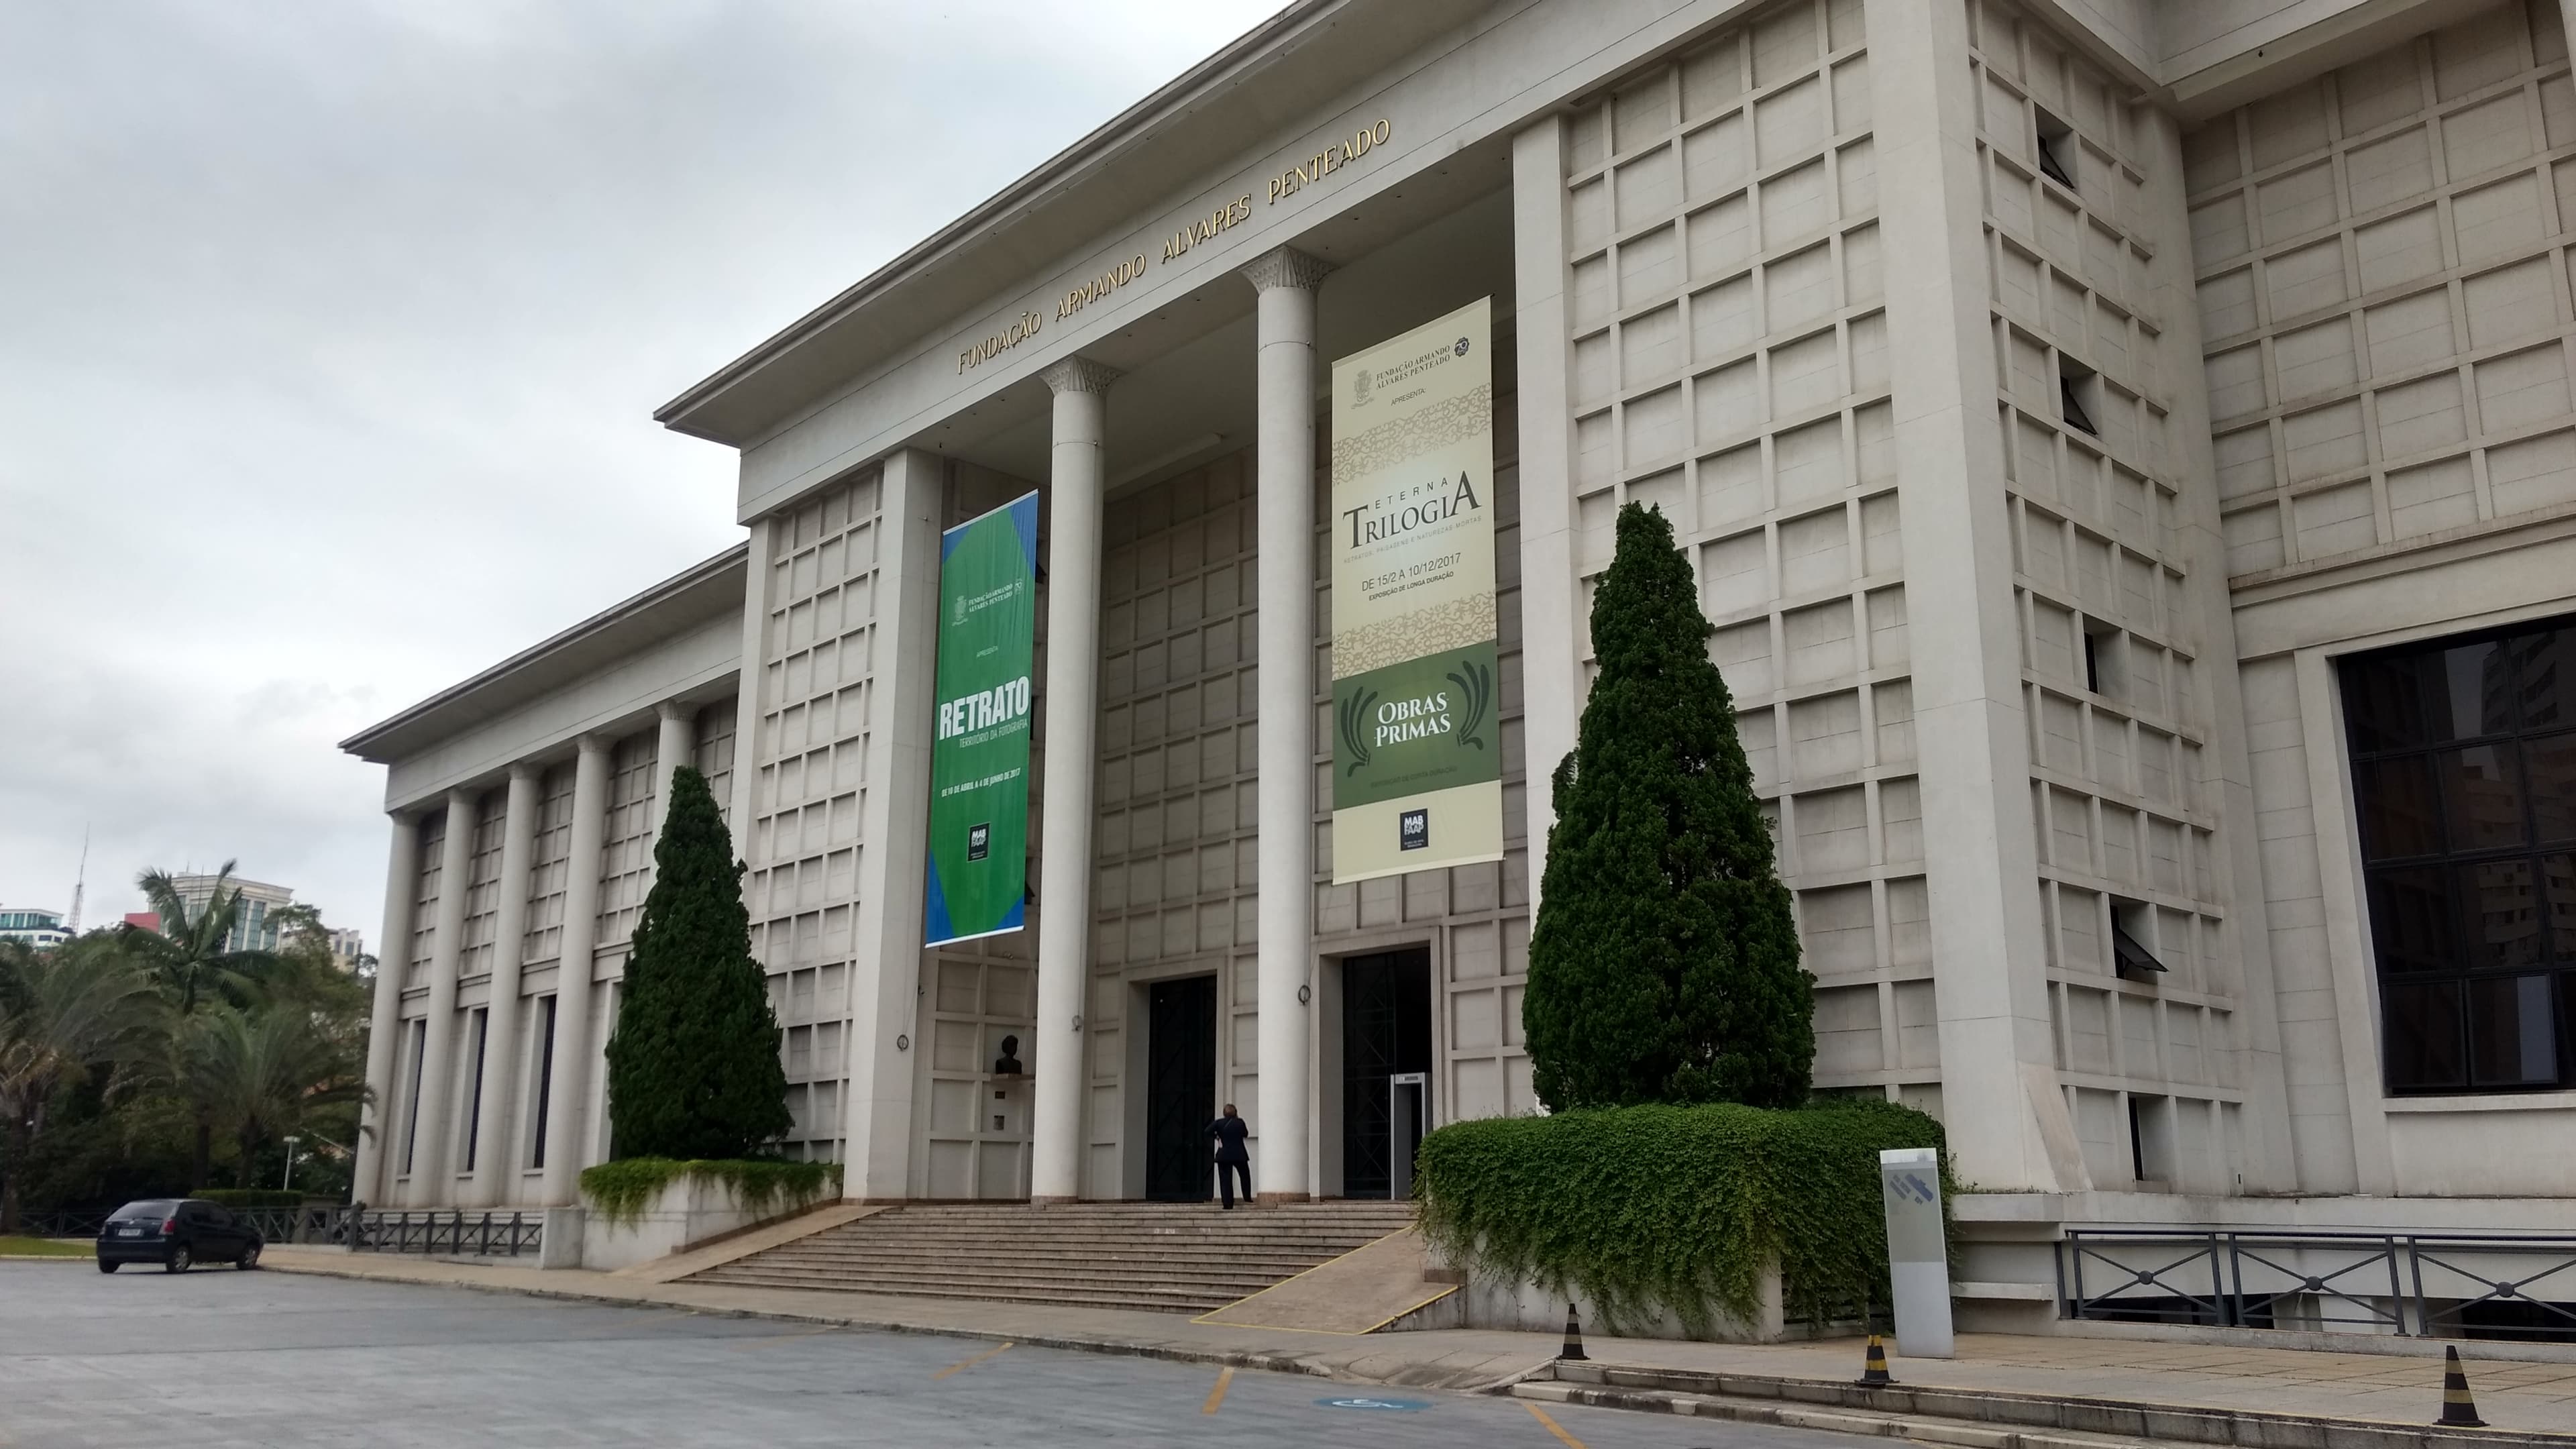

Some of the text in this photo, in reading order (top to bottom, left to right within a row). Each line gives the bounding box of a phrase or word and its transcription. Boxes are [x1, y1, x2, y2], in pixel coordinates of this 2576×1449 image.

[957, 118, 1390, 375] FUNDAÇÃO ARMANDO ALVARES PENTEADO
[1377, 345, 1450, 381] FUNDAÇÃO ARMANDO
[1377, 354, 1450, 390] ALVARES PENTEADO
[1342, 470, 1482, 549] TRILOGIA
[1375, 477, 1448, 509] ETERNA
[1362, 552, 1461, 591] DE 15/2 A 10/12/2017
[1407, 579, 1426, 590] LONGA
[1426, 571, 1454, 584] DURAÇÃO
[939, 676, 1029, 741] RETRATO
[1378, 692, 1448, 724] OBRAS
[1375, 713, 1451, 747] PRIMAS
[1404, 824, 1424, 835] FAAP
[1405, 814, 1424, 826] MAB
